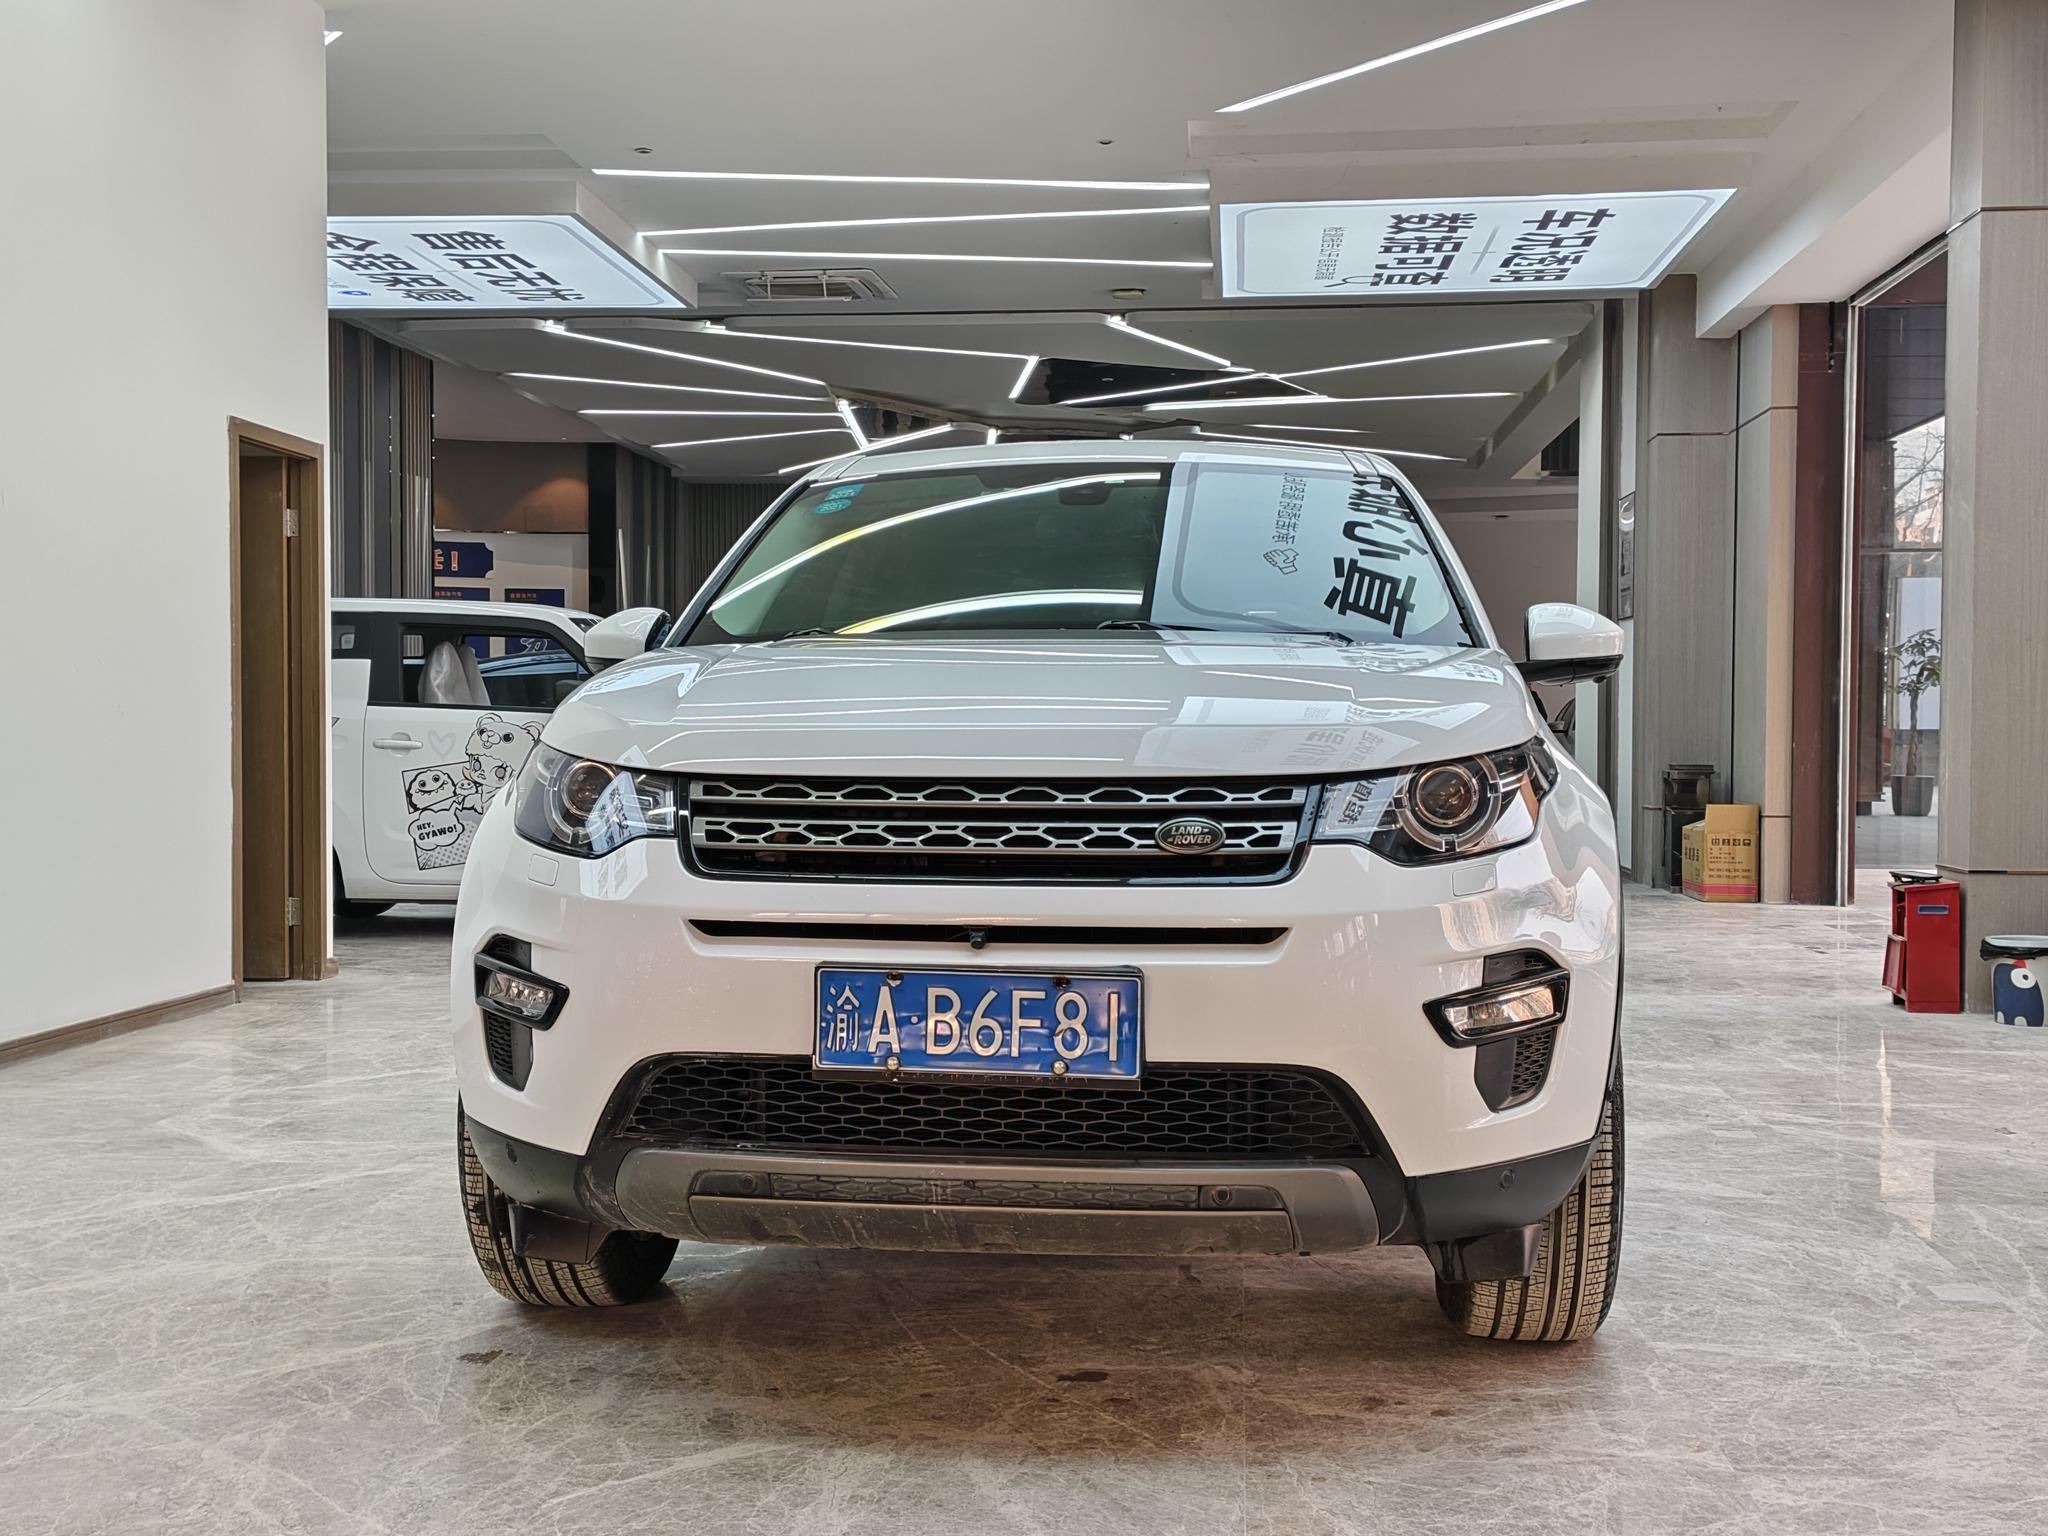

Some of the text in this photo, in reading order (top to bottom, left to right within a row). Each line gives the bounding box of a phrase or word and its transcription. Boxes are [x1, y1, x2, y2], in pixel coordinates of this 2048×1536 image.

[327, 232, 475, 301] 全程保障
[411, 231, 585, 301] 售后无忧
[1374, 212, 1477, 287] 数据可查
[1489, 208, 1617, 283] 车况透明
[418, 824, 458, 841] GYAWO!
[1171, 826, 1203, 835] LAND
[1173, 834, 1213, 845] ROVER
